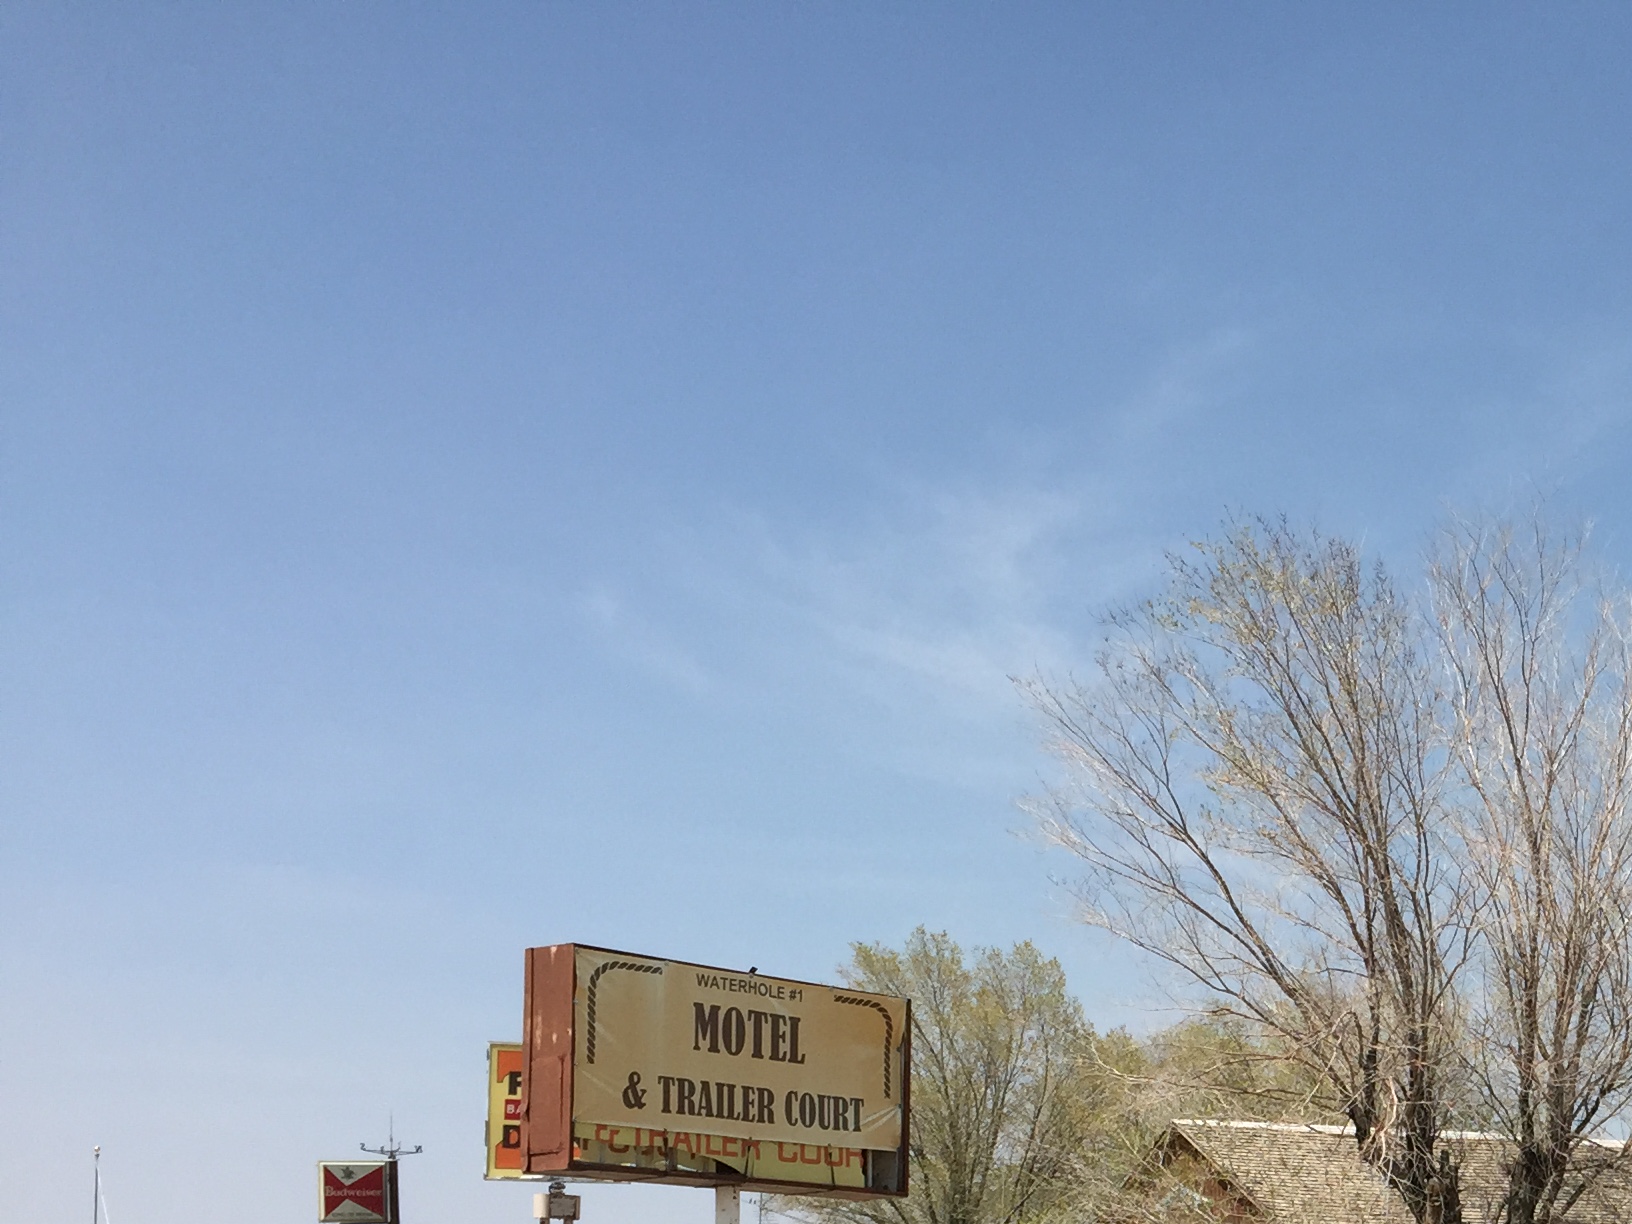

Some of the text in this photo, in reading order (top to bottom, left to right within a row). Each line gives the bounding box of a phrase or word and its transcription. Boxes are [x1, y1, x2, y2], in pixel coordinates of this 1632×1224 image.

[696, 973, 803, 1003] WATERHOLE #1
[692, 1002, 806, 1065] MOTEL
[622, 1071, 865, 1132] & TRAILER COURT
[325, 1185, 383, 1197] Budweiser
